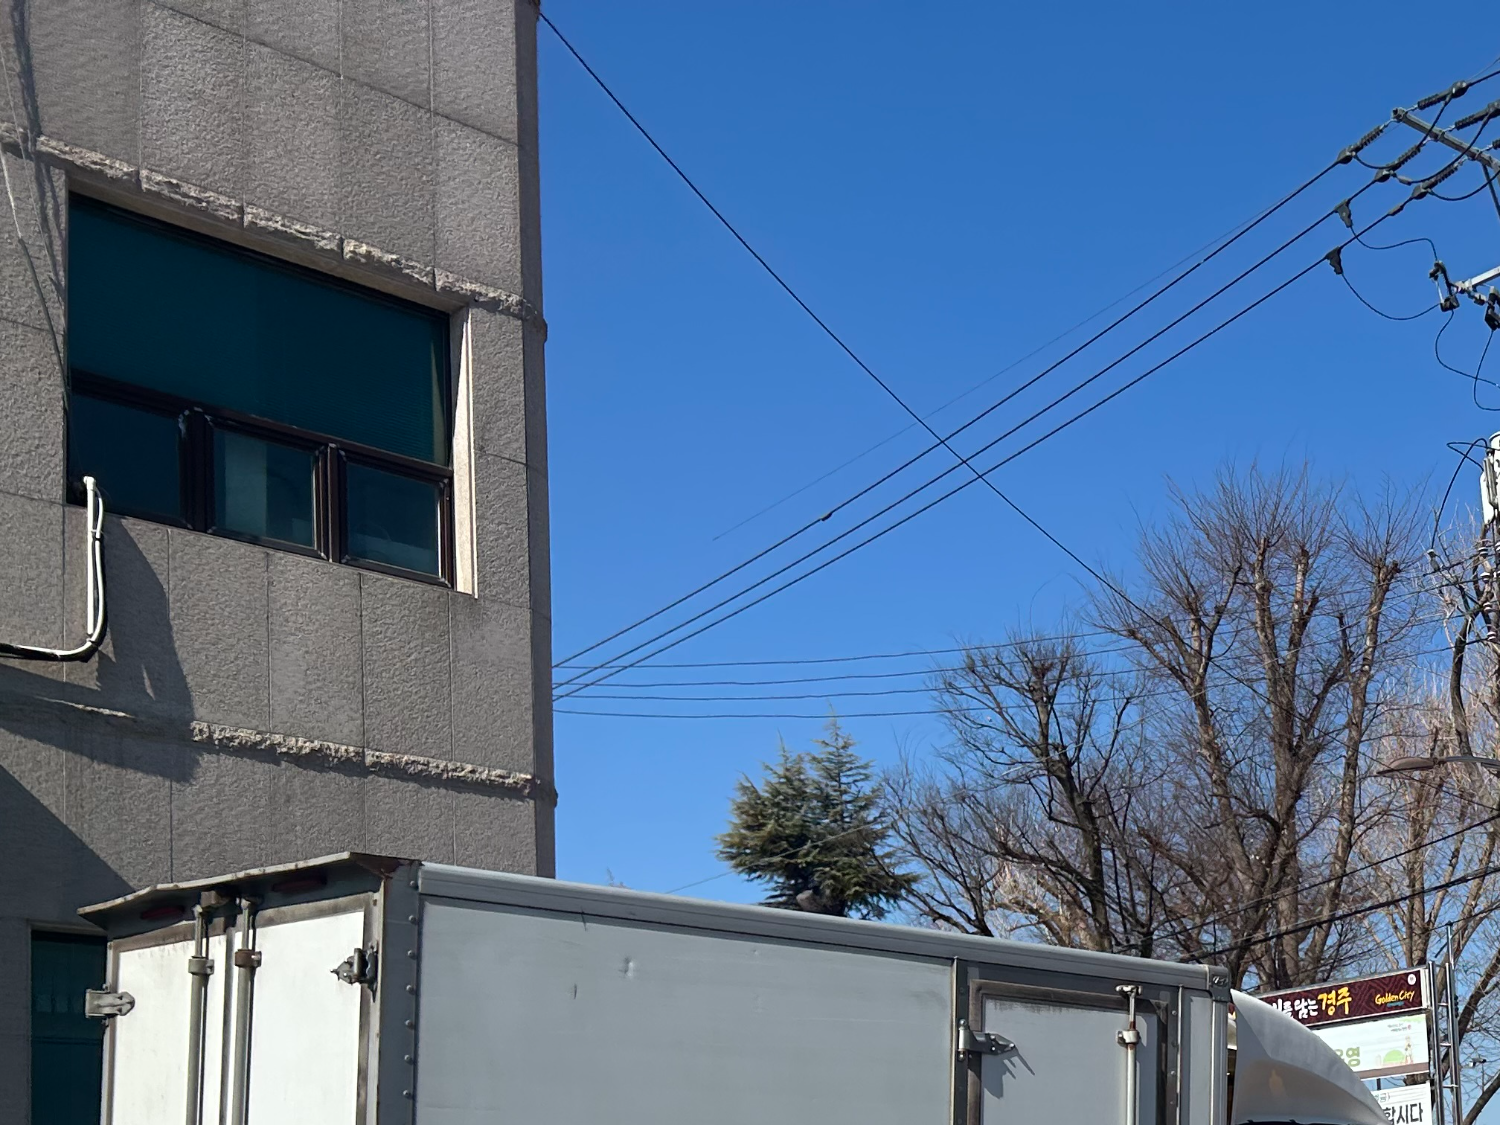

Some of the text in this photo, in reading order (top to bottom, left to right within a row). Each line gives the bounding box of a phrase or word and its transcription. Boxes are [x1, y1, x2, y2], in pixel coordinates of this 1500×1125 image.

[1294, 998, 1318, 1019] 담는
[1317, 986, 1352, 1016] 경주
[1375, 993, 1398, 1005] Golden
[1398, 990, 1415, 1002] City
